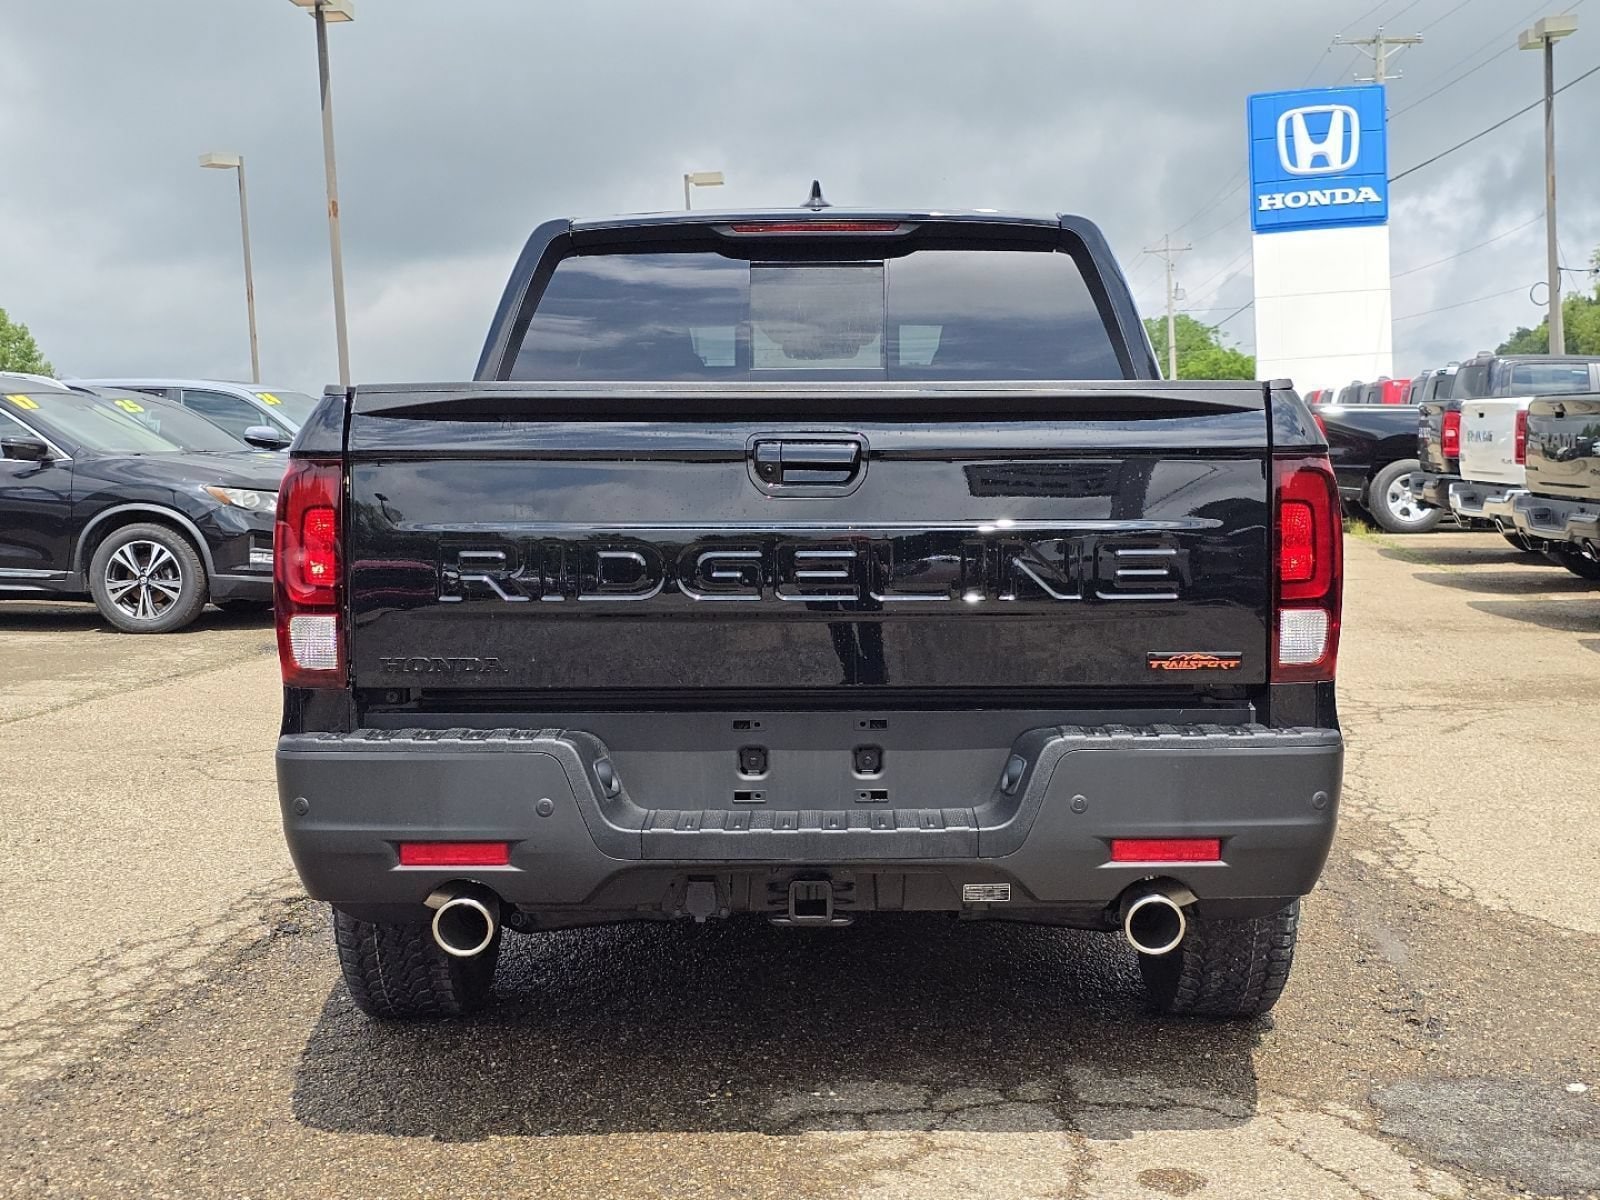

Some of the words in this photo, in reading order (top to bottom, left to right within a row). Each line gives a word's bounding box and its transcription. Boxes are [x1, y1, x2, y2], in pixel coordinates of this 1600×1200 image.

[1258, 186, 1382, 211] HONDA
[1538, 433, 1577, 449] RAM
[437, 539, 1181, 603] RIDGELINE
[379, 657, 509, 672] HONDA
[1149, 660, 1241, 670] TRAILSPORT
